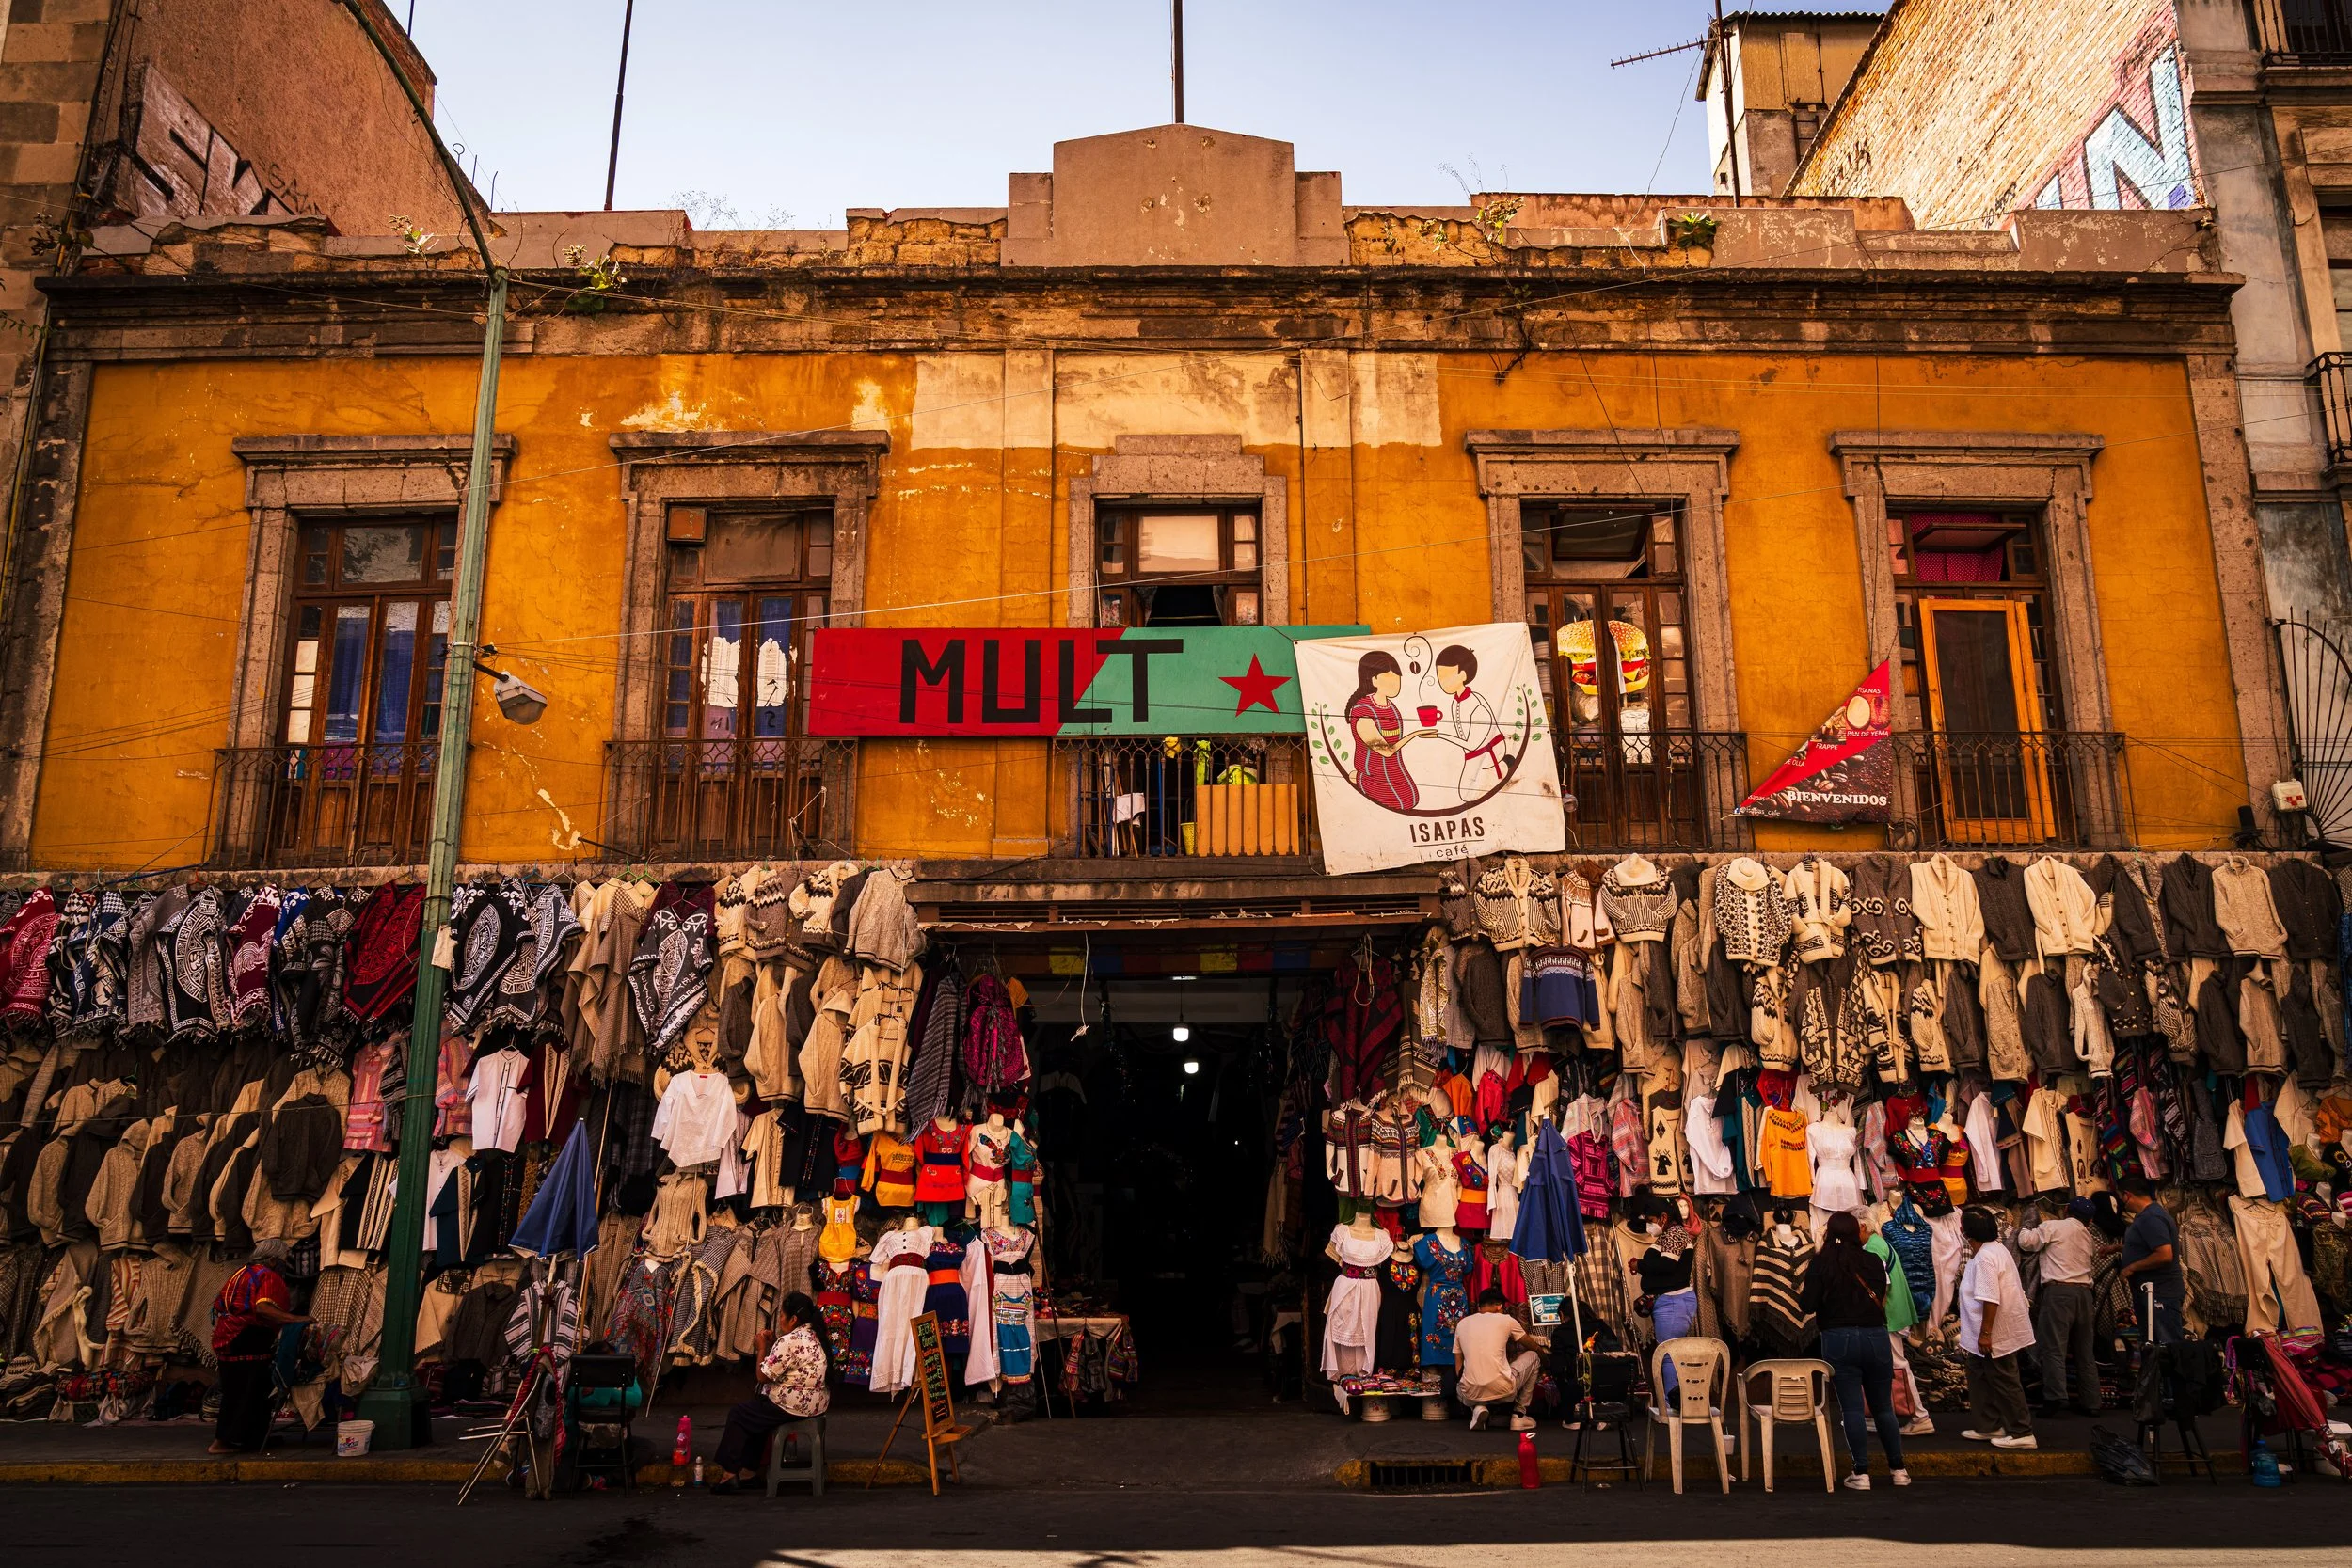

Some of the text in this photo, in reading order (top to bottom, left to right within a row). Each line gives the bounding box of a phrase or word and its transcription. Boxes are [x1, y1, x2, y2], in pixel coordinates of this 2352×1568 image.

[899, 639, 1184, 723] MULT
[1791, 758, 1805, 768] OLLA
[1788, 790, 1887, 806] BIENVENIDOS
[1409, 816, 1485, 843] ISAPAS
[1436, 844, 1469, 858] café
